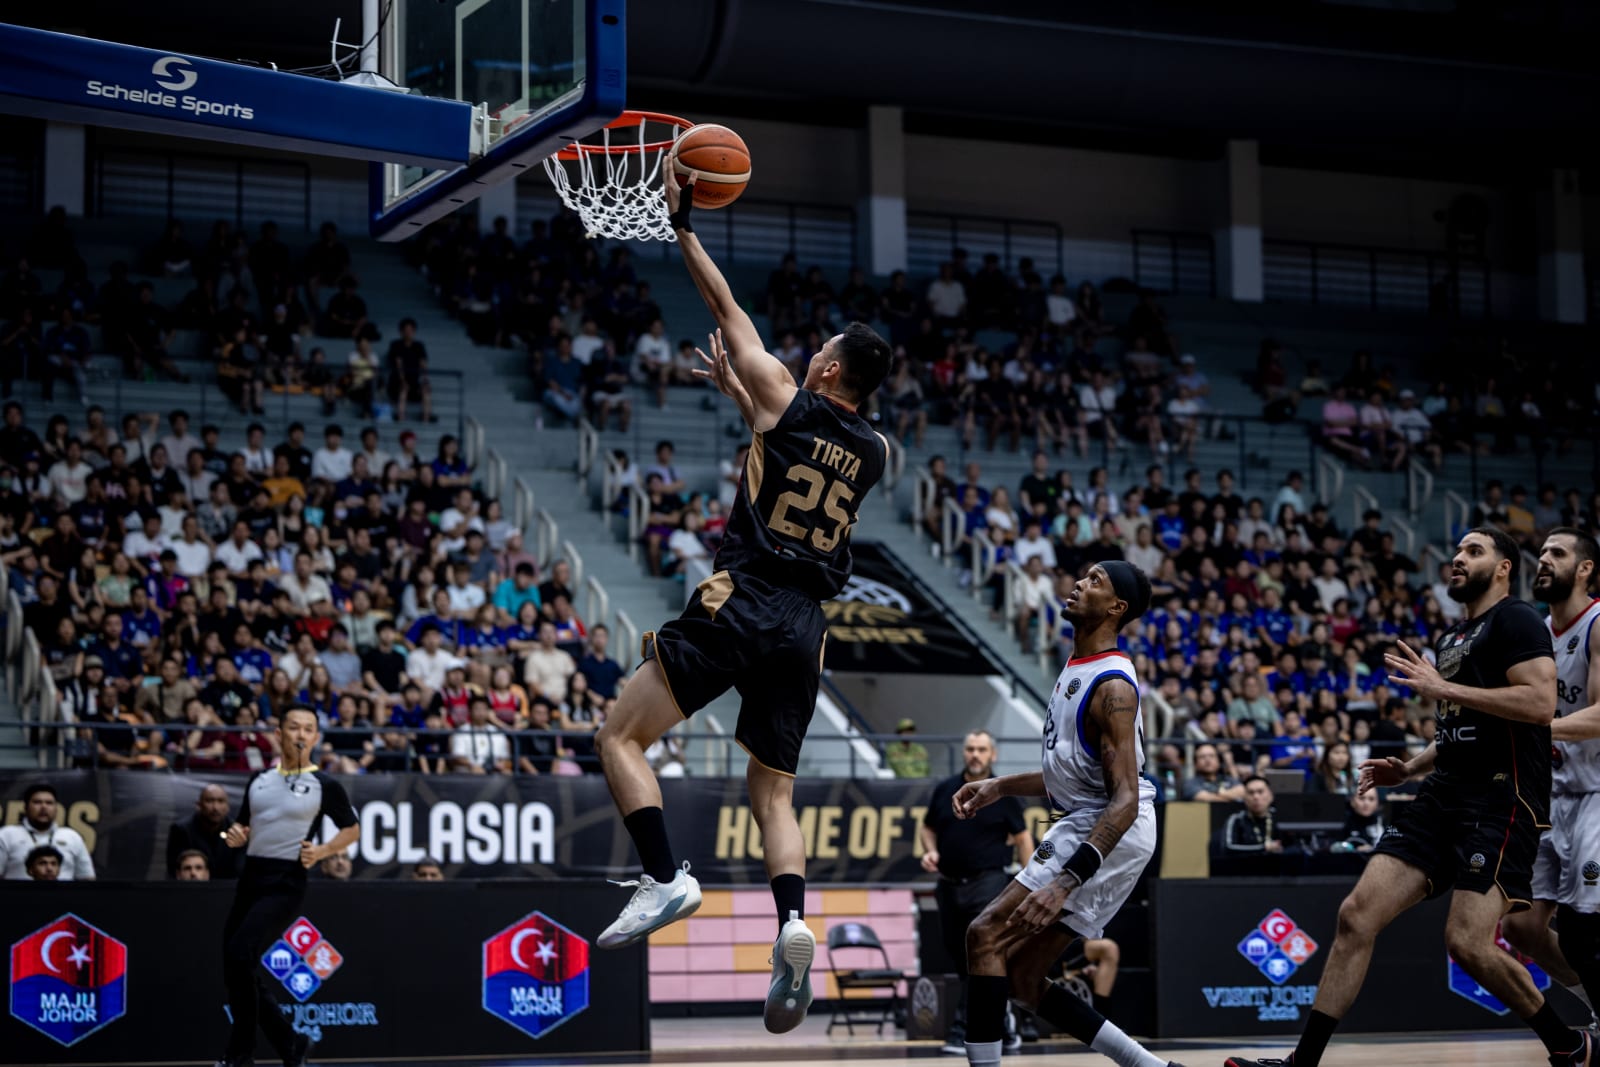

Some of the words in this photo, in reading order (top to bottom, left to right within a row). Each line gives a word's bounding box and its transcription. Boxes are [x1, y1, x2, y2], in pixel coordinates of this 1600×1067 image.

[86, 80, 177, 108] Schelde
[181, 95, 255, 120] Sports
[810, 436, 863, 482] TIRTA
[767, 463, 856, 553] 25
[847, 805, 905, 860] OF
[40, 992, 97, 1009] MAJU
[509, 986, 563, 1002] MAJU
[1201, 985, 1269, 1008] VISIT
[1268, 985, 1318, 1008] JOH
[38, 1008, 98, 1023] JOHOR
[291, 1002, 379, 1027] JOHOR
[508, 1001, 564, 1016] JOHOR
